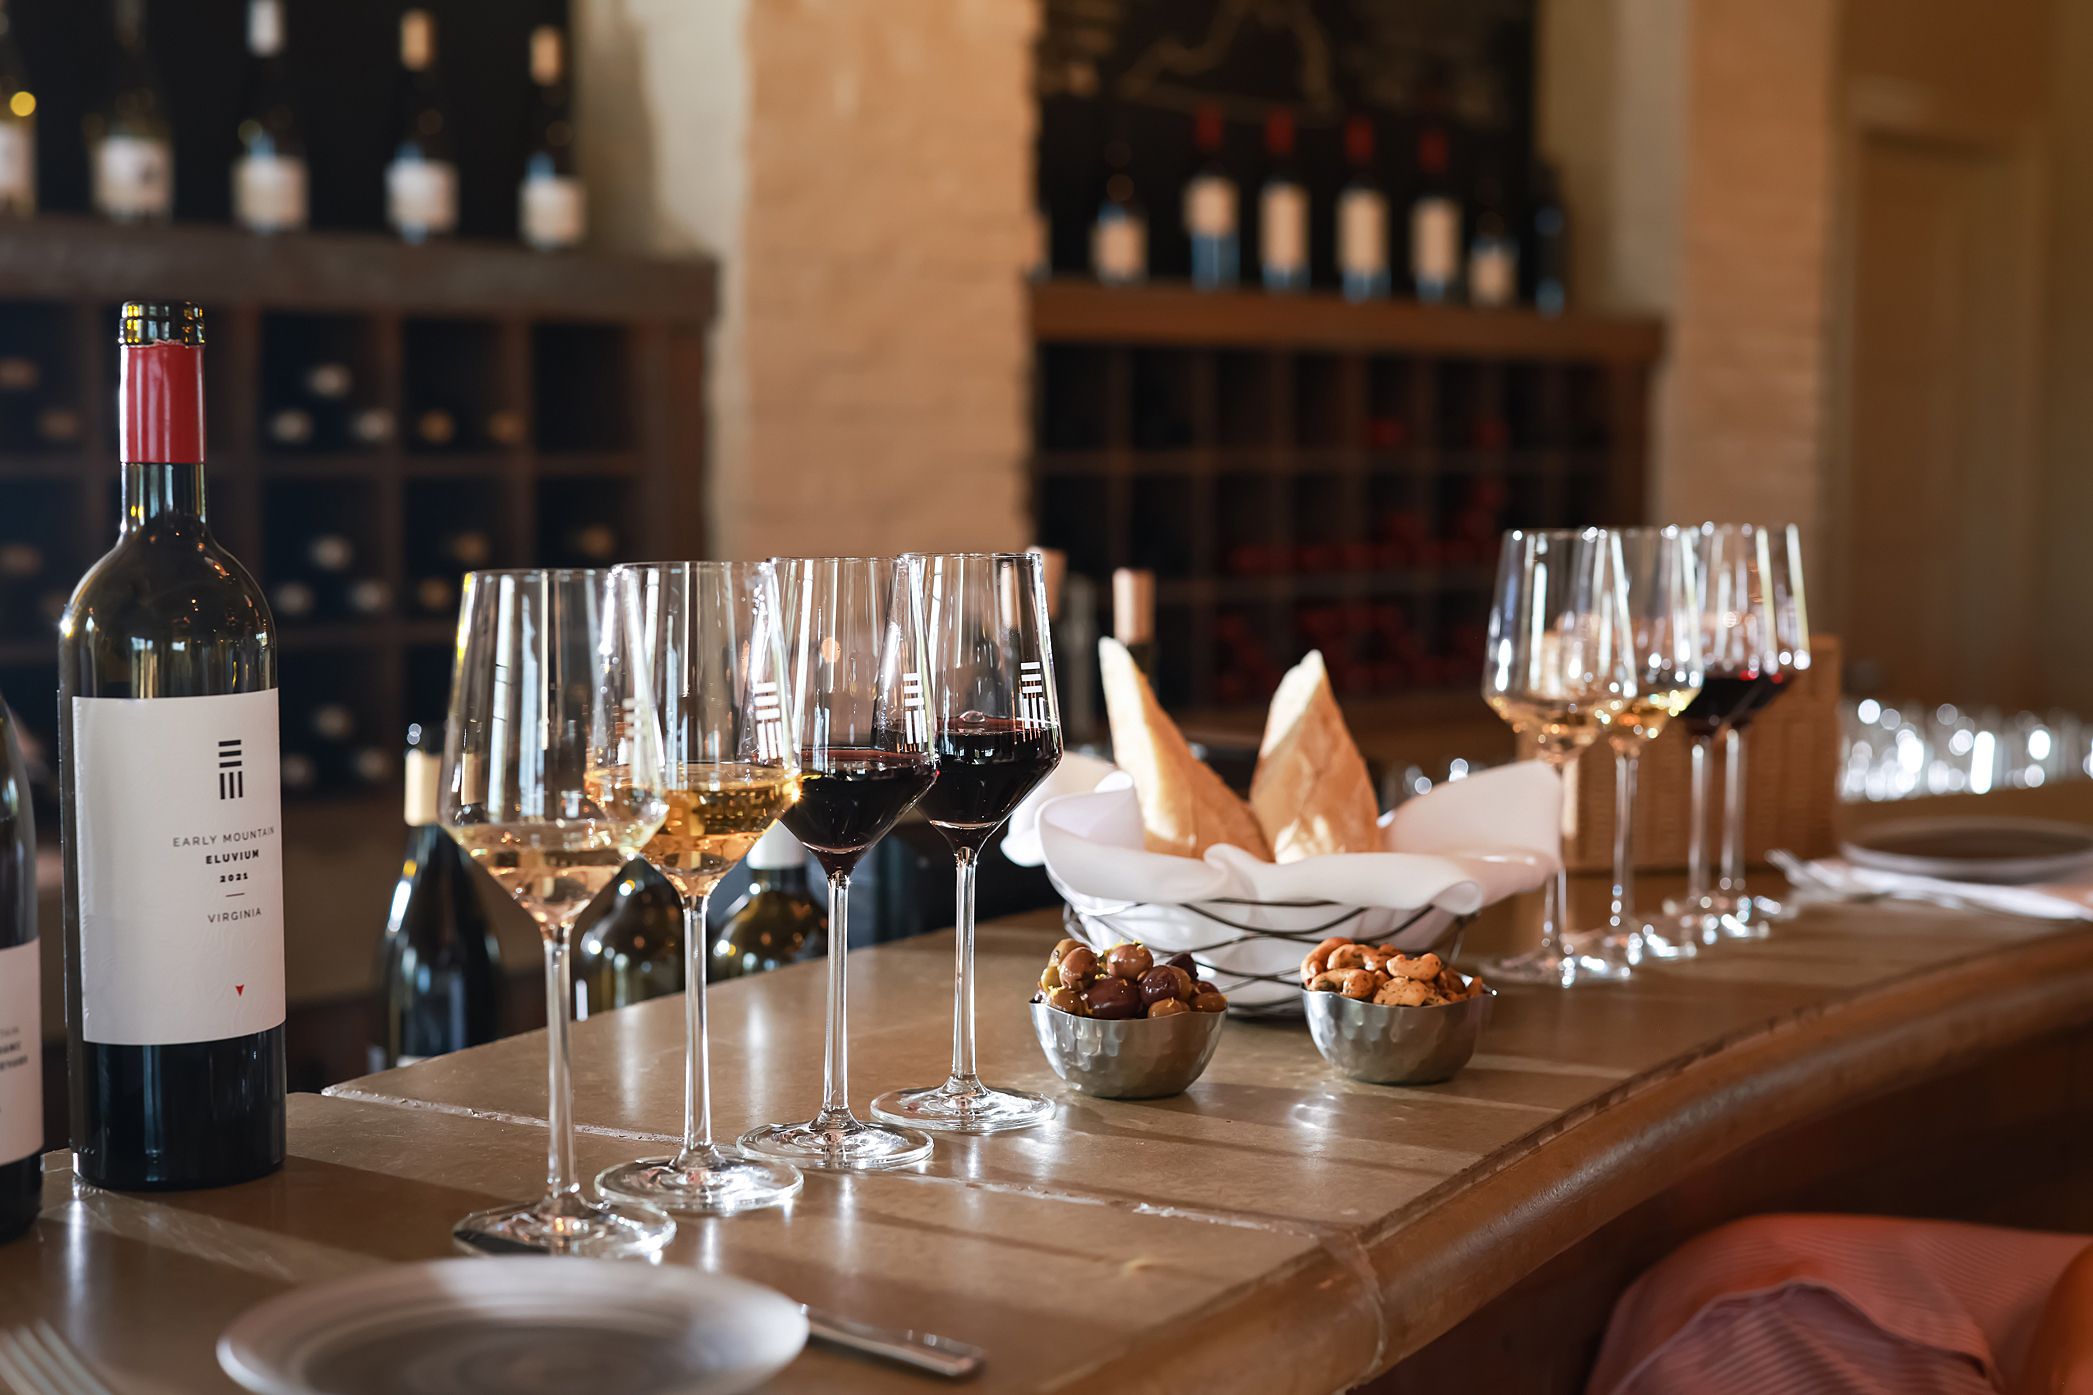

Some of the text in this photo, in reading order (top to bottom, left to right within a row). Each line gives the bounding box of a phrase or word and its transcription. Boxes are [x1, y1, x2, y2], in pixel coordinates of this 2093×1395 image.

[173, 826, 275, 847] EARLY MOUNTAIN
[205, 849, 259, 865] ELUVIUM
[219, 872, 248, 883] 2021
[207, 907, 262, 923] VIRGINIA
